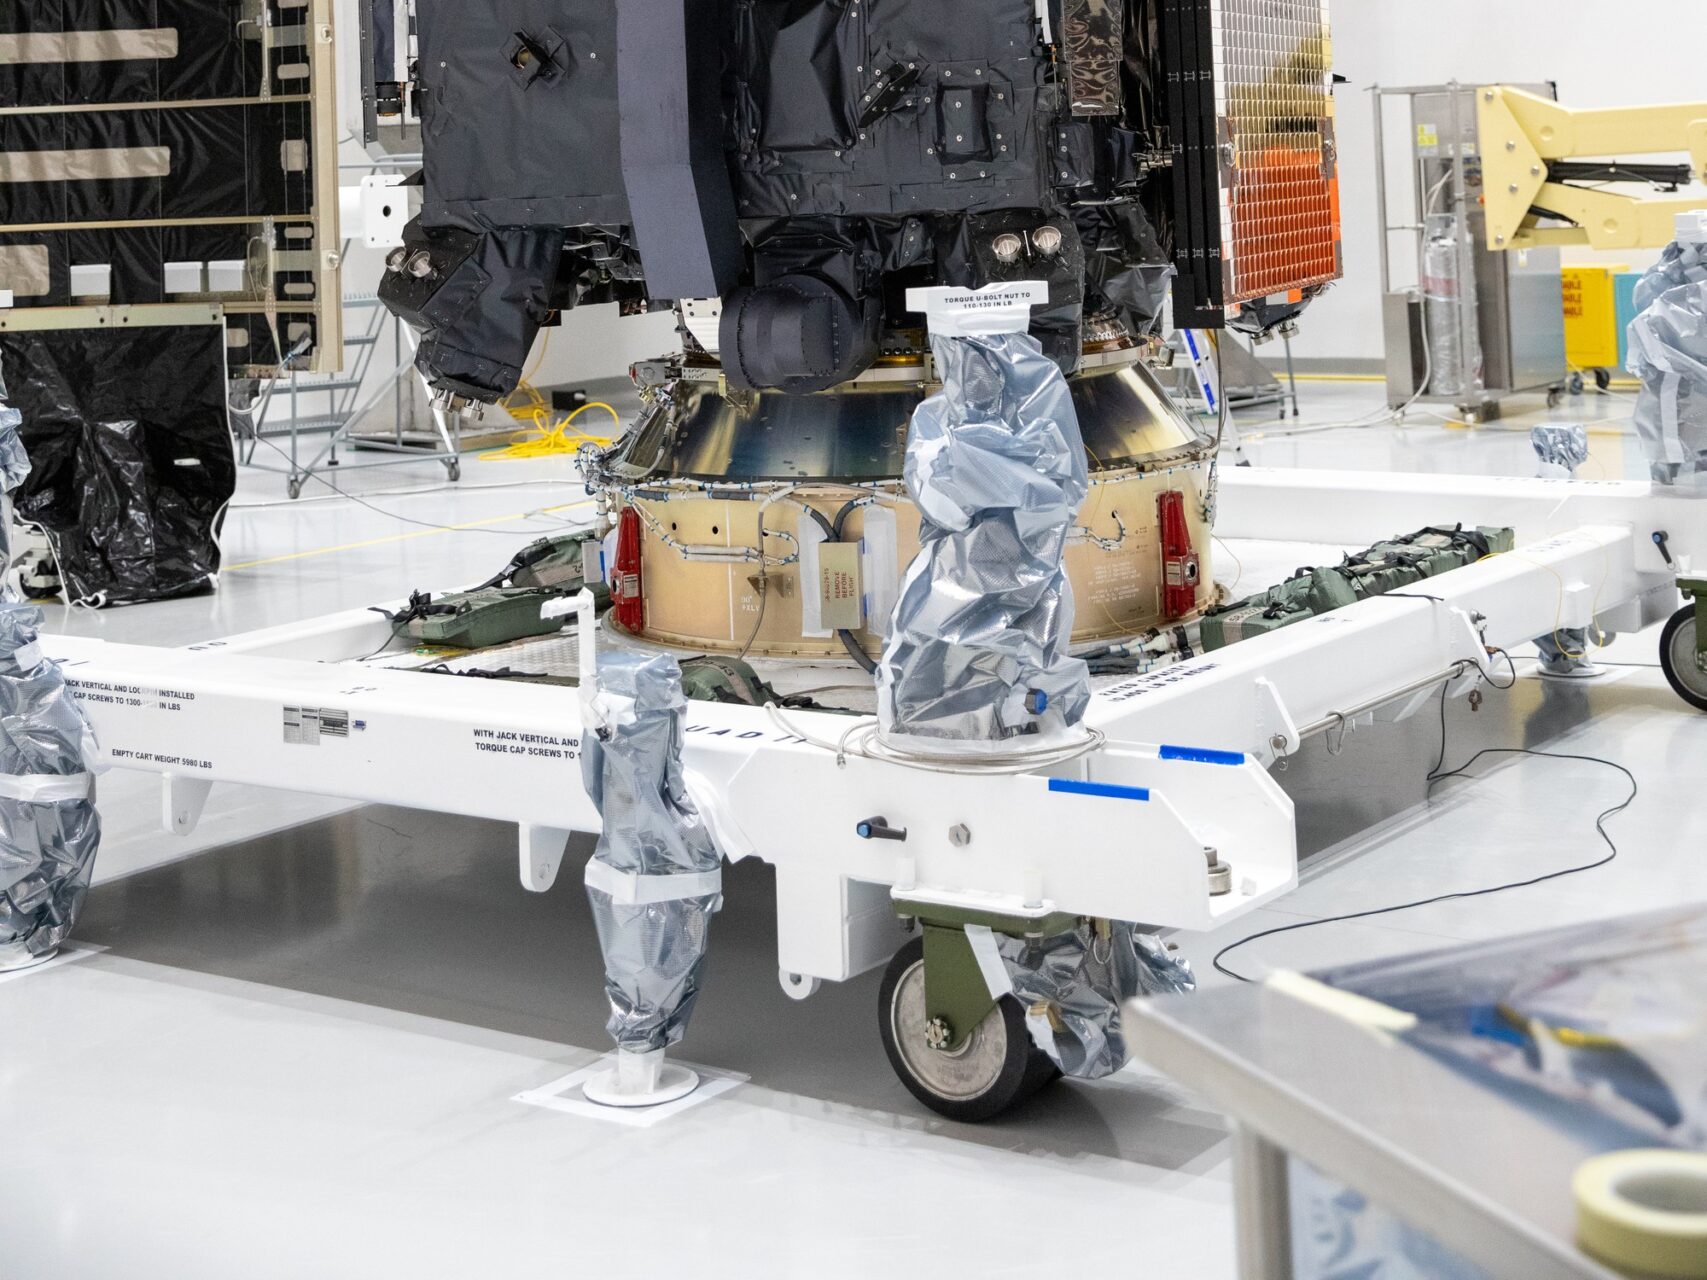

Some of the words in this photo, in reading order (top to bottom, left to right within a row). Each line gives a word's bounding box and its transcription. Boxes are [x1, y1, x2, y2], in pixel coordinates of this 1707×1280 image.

[945, 295, 974, 303] TORQUE
[81, 681, 112, 691] VERTICAL
[114, 685, 127, 693] AND
[159, 689, 195, 700] INSTALLED
[73, 691, 87, 700] CAP
[88, 693, 114, 703] SCREWS
[115, 696, 124, 704] TO
[168, 703, 181, 711] LBS
[473, 729, 494, 738] WITH
[496, 731, 518, 741] JACK
[519, 734, 559, 746] VERTICAL
[561, 738, 579, 747] AND
[112, 748, 133, 758] EMPTY
[135, 751, 153, 761] CART
[154, 754, 180, 764] WEIGHT
[182, 758, 198, 767] 5980
[199, 760, 213, 768] LBS
[475, 742, 508, 753] TORQUE
[510, 745, 526, 754] CAP
[528, 748, 562, 758] SCREWS
[564, 750, 575, 759] TO
